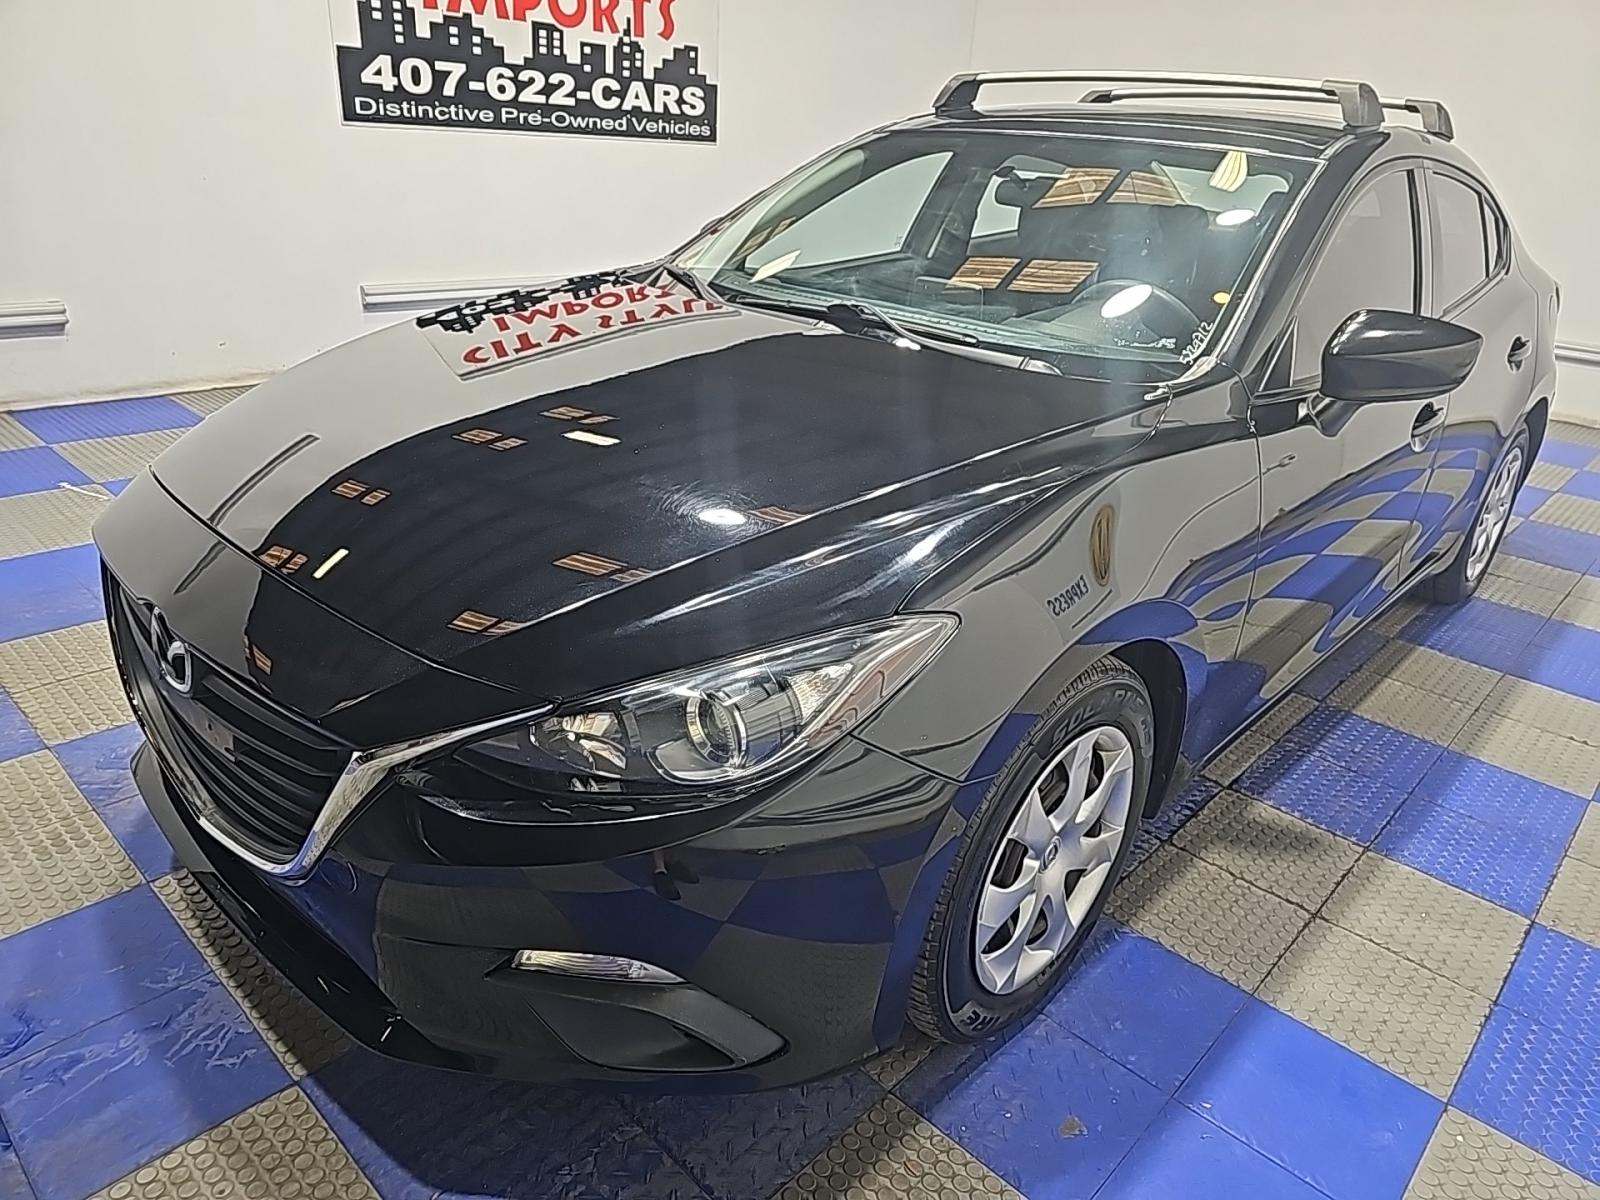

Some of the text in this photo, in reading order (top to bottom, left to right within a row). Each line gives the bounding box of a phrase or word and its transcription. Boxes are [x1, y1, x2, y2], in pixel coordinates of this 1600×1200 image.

[423, 0, 675, 41] PORTS
[359, 54, 706, 117] 407-622-CARS
[354, 96, 712, 137] Distinctive Pre-Owned Vehicles
